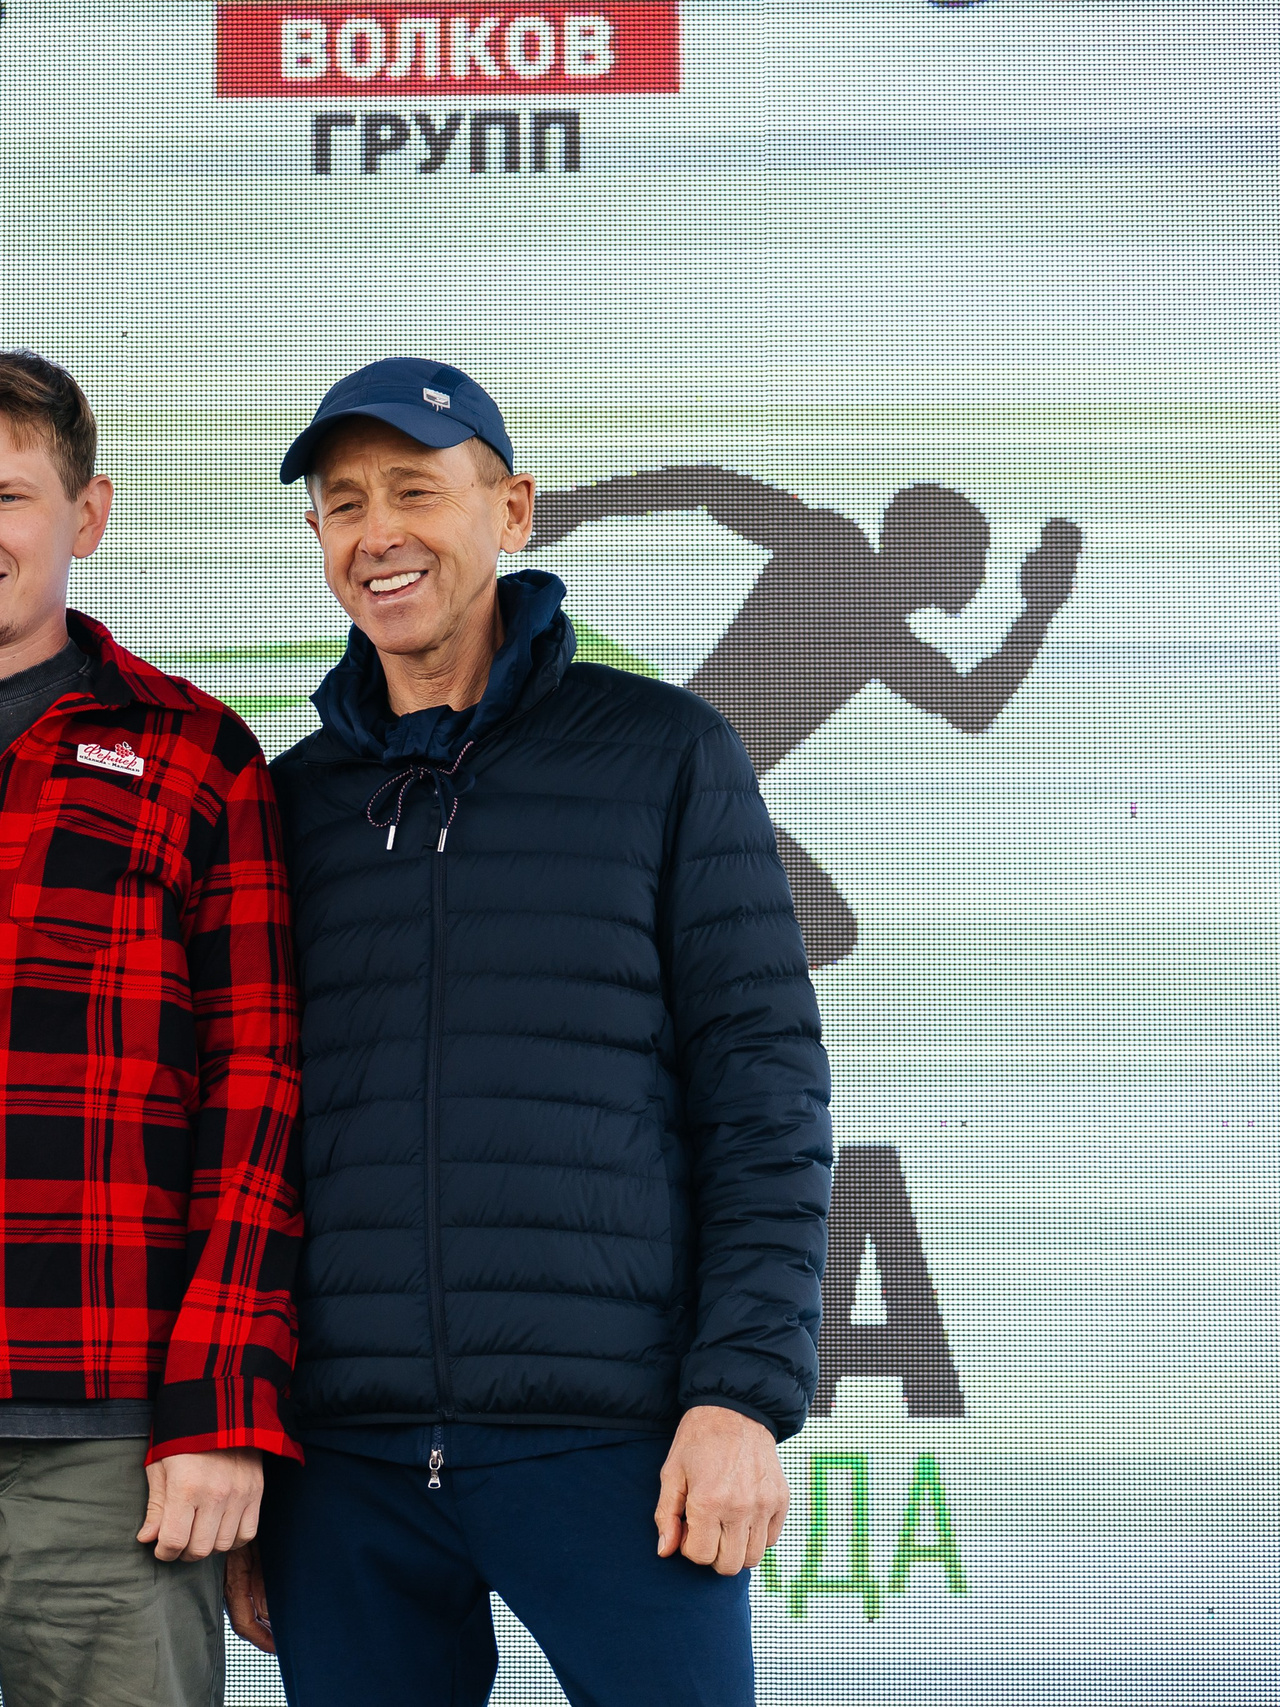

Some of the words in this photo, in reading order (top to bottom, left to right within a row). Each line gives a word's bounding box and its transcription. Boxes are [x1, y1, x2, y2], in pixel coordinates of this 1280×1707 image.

[278, 15, 616, 81] ВОЛКОВ
[312, 110, 581, 174] ГРУПП
[83, 744, 138, 769] Фермер
[765, 1453, 967, 1622] ДА
